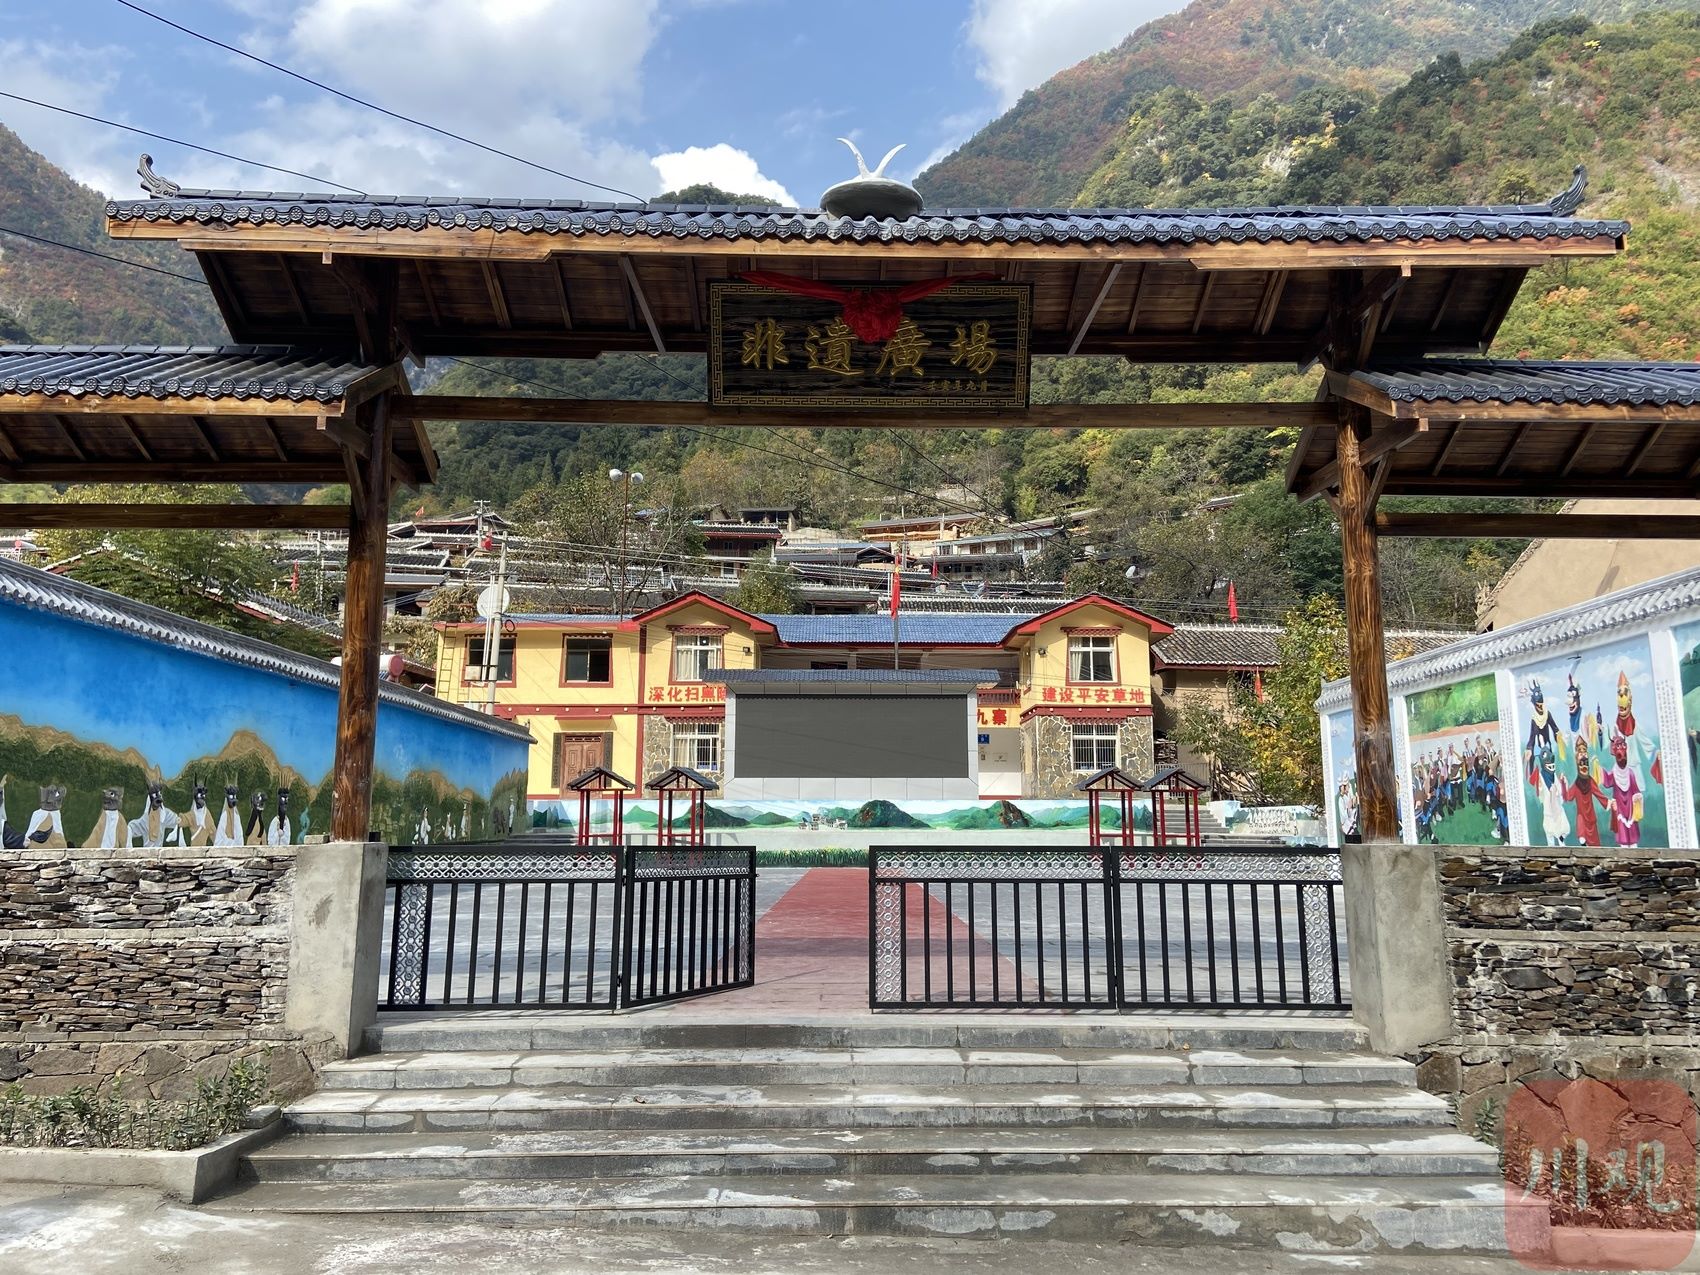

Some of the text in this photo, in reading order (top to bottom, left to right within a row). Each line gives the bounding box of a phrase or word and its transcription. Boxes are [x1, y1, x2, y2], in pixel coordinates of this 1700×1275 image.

[1042, 687, 1145, 704] 建设平安草地
